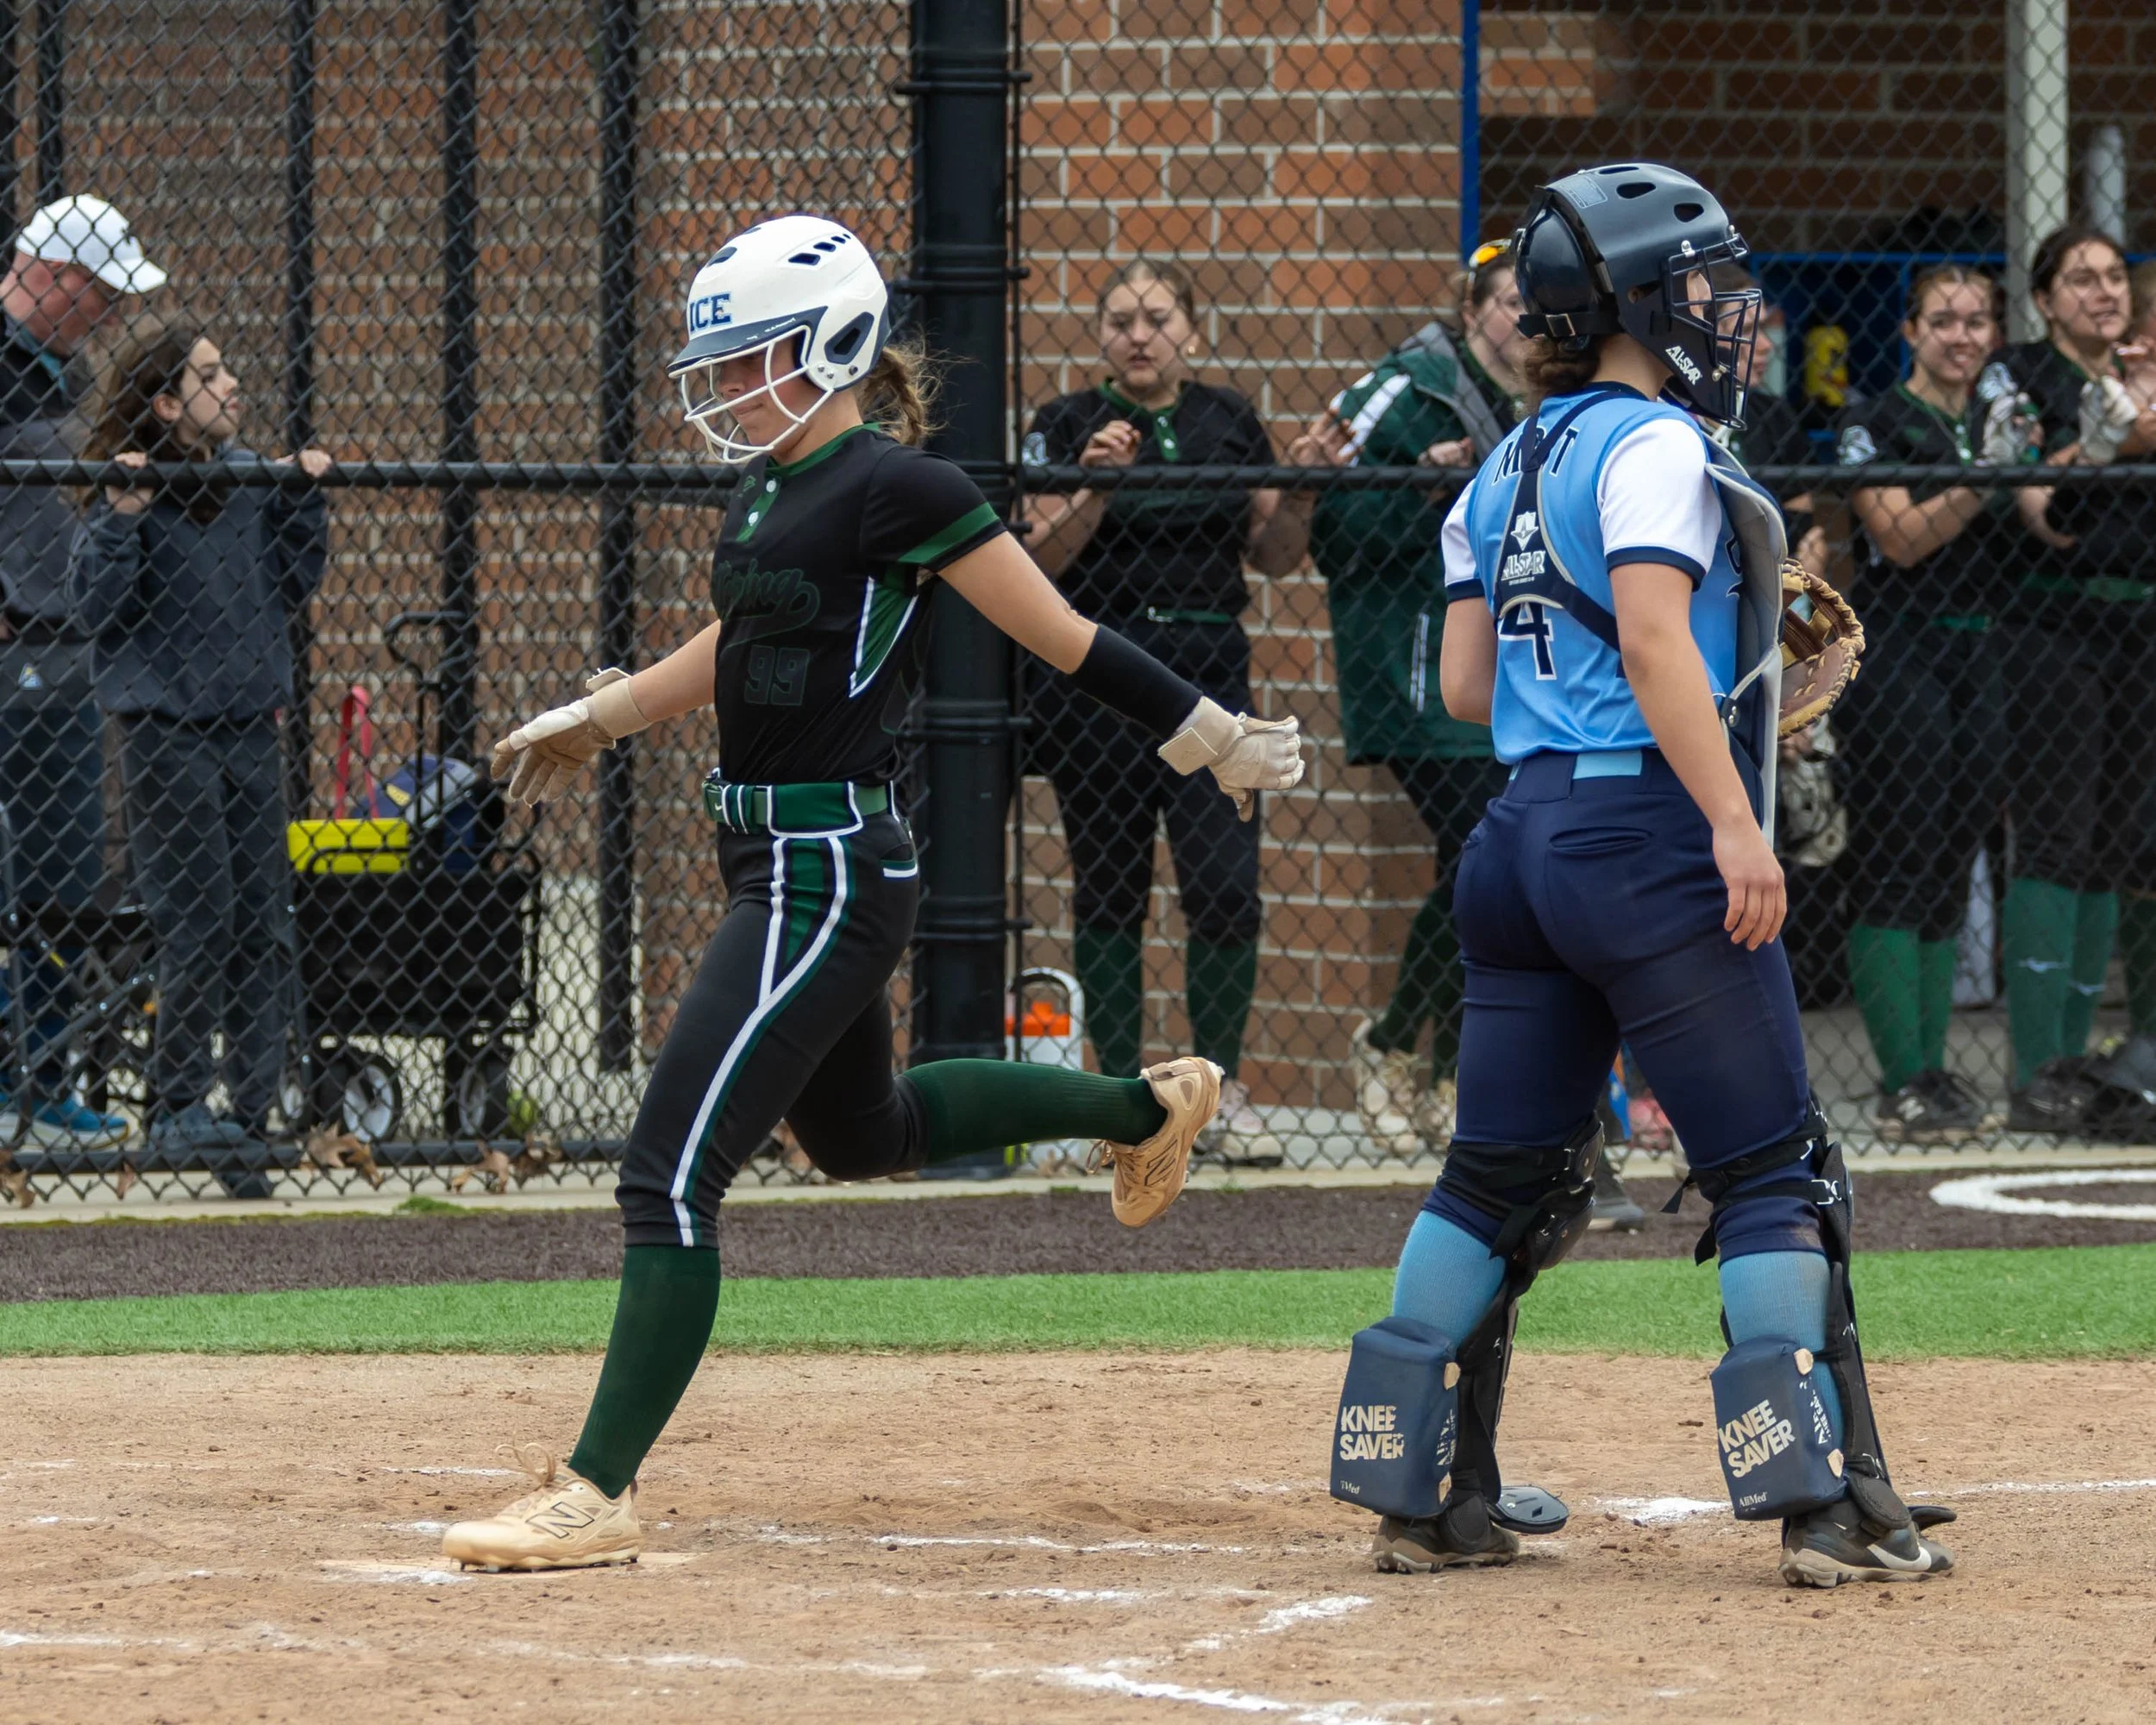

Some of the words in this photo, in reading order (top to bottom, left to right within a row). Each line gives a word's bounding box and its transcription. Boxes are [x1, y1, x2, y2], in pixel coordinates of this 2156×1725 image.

[690, 292, 732, 332] ICE
[1498, 602, 1557, 681] 4
[744, 644, 811, 706] 99
[1340, 1405, 1397, 1433] KNEE
[1718, 1399, 1777, 1454] KNEE
[1339, 1433, 1405, 1461] SAVER
[1727, 1419, 1796, 1479] SAVER
